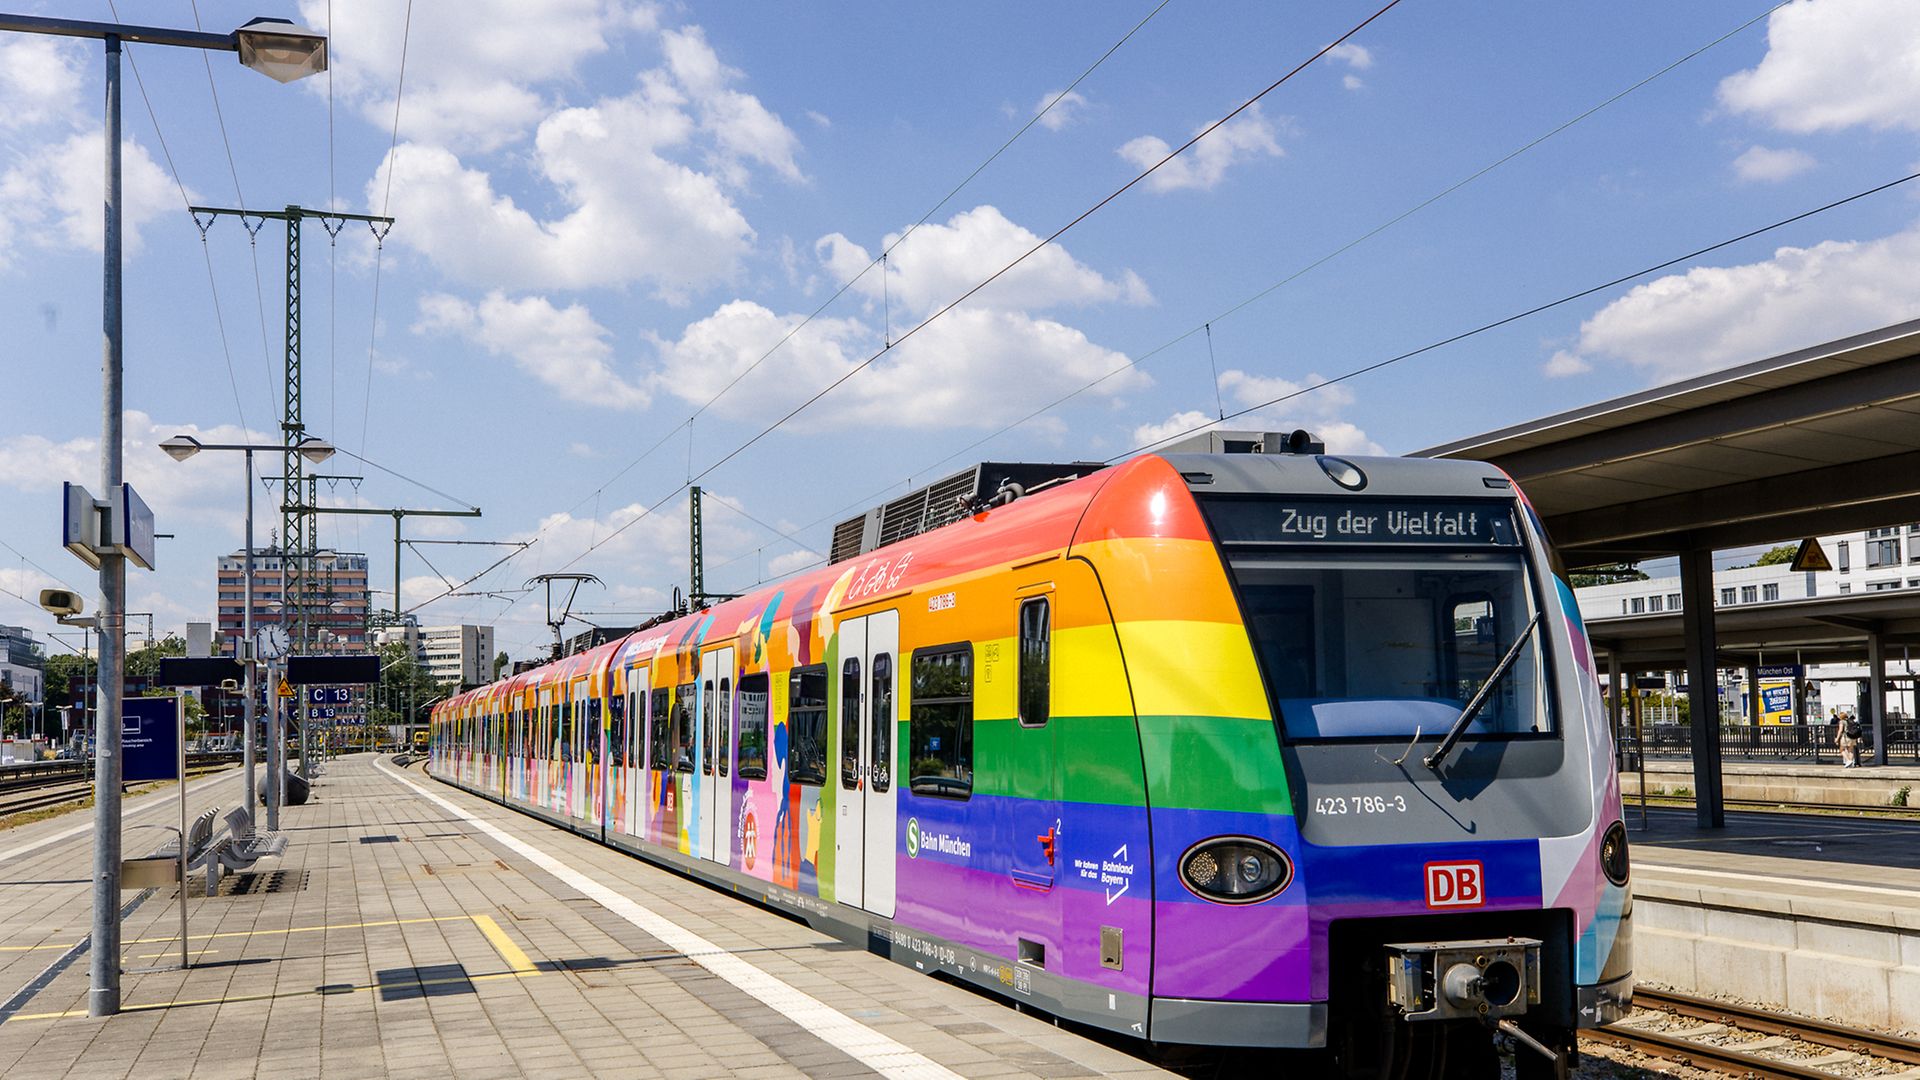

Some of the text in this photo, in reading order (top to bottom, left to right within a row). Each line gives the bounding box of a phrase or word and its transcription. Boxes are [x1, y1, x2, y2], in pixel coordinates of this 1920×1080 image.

[1281, 508, 1478, 538] Zug der Vielfalt
[1757, 667, 1793, 675] München Ost
[314, 689, 348, 701] C 13
[311, 708, 335, 717] B 13
[1315, 795, 1407, 815] 423 786-3
[1056, 818, 1062, 835] 2
[908, 821, 971, 857] S Bahn München
[1102, 860, 1134, 875] Bahnland
[1101, 872, 1124, 886] Bayern
[1431, 868, 1478, 902] DB
